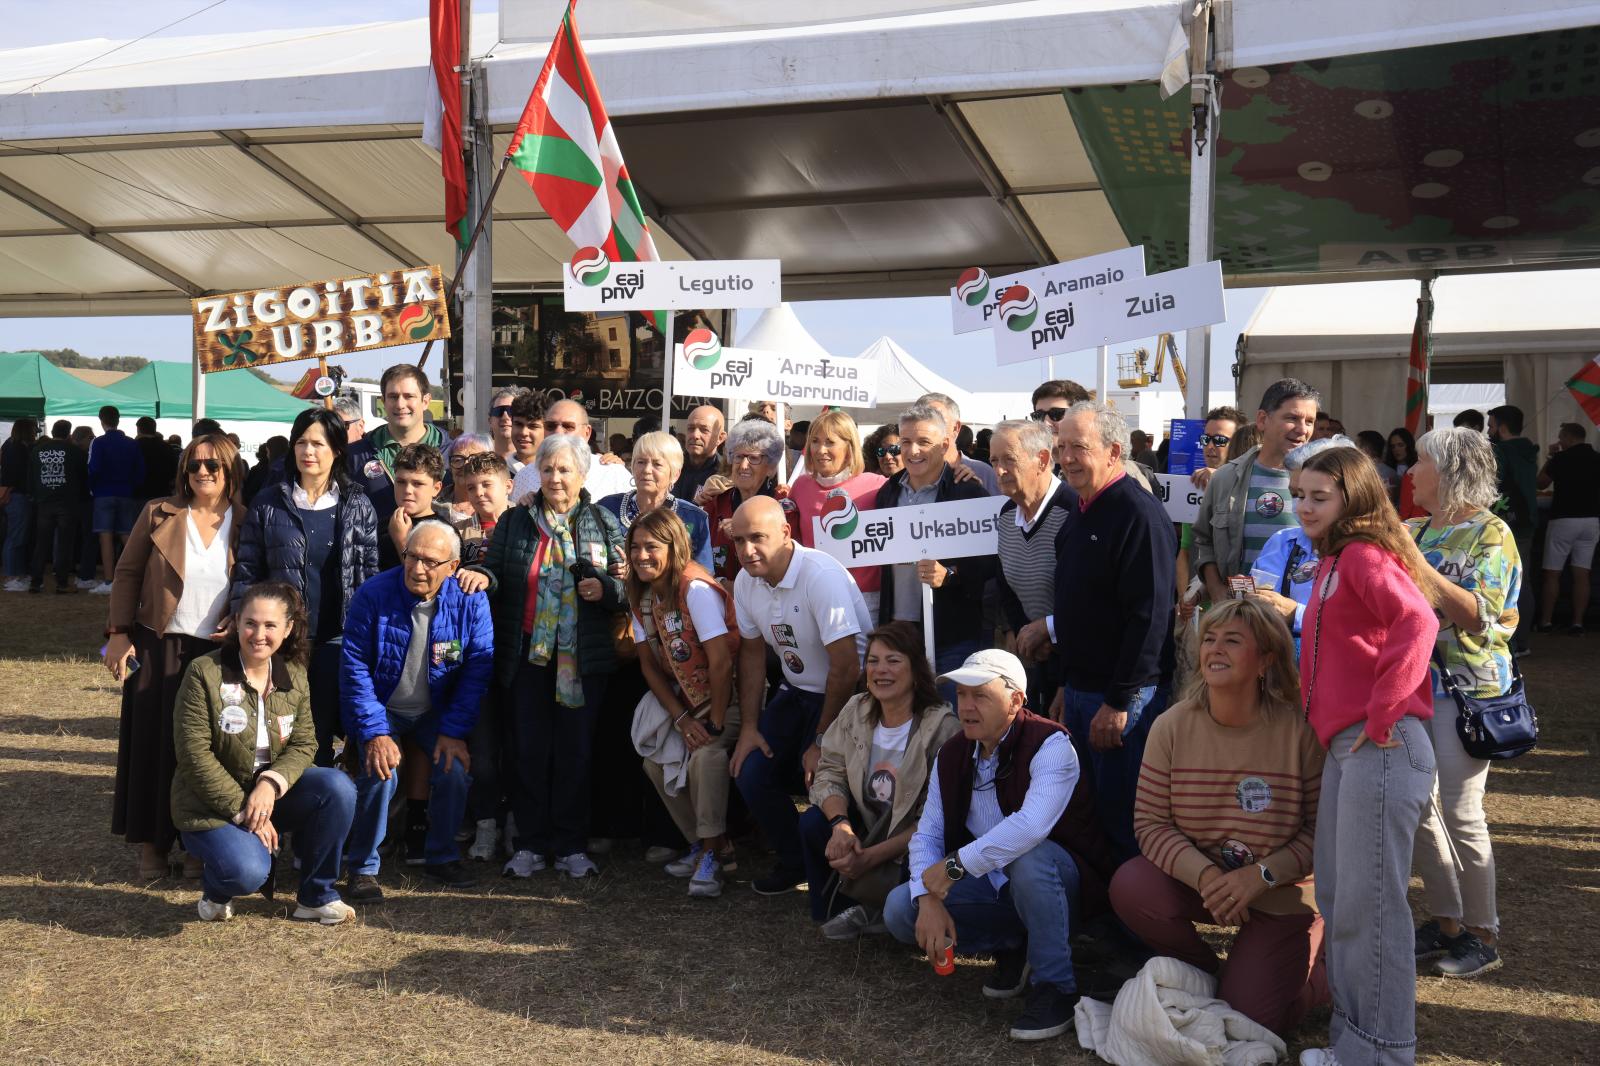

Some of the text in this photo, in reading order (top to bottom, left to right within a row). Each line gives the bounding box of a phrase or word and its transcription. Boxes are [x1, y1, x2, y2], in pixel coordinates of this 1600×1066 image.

[615, 269, 644, 290] eaj
[679, 274, 754, 294] Legutio
[1044, 268, 1124, 298] Aramaio
[601, 286, 637, 303] pnv
[1125, 292, 1175, 318] Zuia
[1044, 302, 1075, 327] eaj
[272, 313, 383, 358] UBB
[1031, 324, 1067, 350] pnv
[725, 358, 753, 378] eaj
[711, 372, 744, 389] pnv
[767, 379, 869, 402] Ubarrundia
[39, 449, 66, 458] SOUND
[40, 456, 65, 464] WOOD
[864, 516, 894, 540] eaj
[909, 513, 1000, 540] Urkabust
[851, 537, 887, 559] pnv
